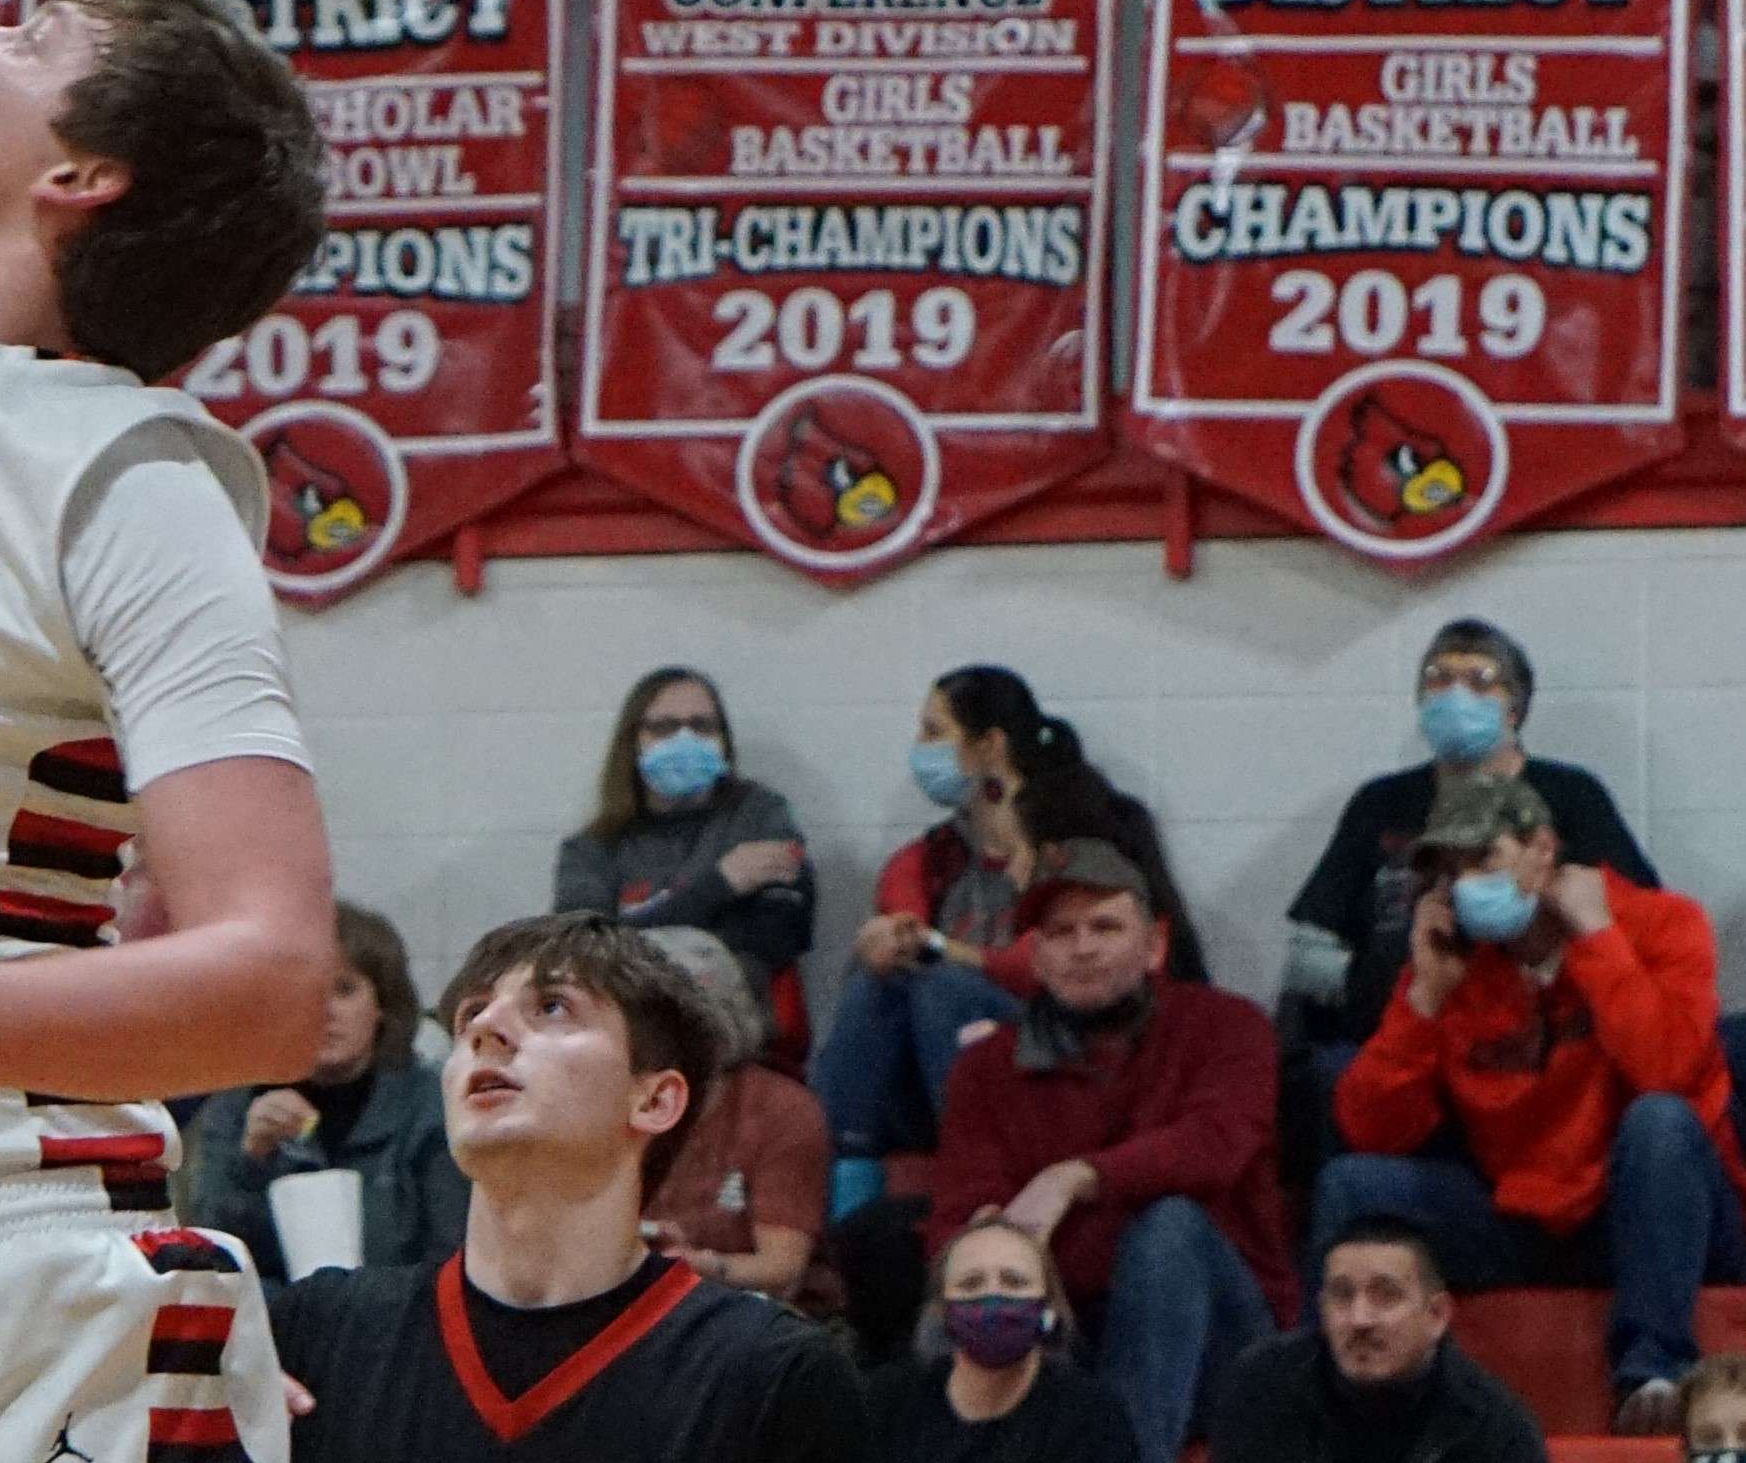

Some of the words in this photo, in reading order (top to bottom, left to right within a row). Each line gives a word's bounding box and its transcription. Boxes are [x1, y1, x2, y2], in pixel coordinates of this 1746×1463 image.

[641, 19, 801, 55] WEST
[814, 17, 1079, 55] DIVISION
[821, 74, 975, 126] GIRLS
[1379, 52, 1538, 104] GIRLS
[730, 126, 1073, 177] BASKETBALL
[1282, 104, 1639, 158] BASKETBALL
[292, 224, 533, 303] PIONS
[619, 204, 1084, 287] TRI-CHAMPIONS
[1172, 181, 1652, 274] CHAMPIONS
[709, 285, 978, 373] 2019
[1266, 268, 1548, 359] 2019
[183, 309, 440, 400] 2019
